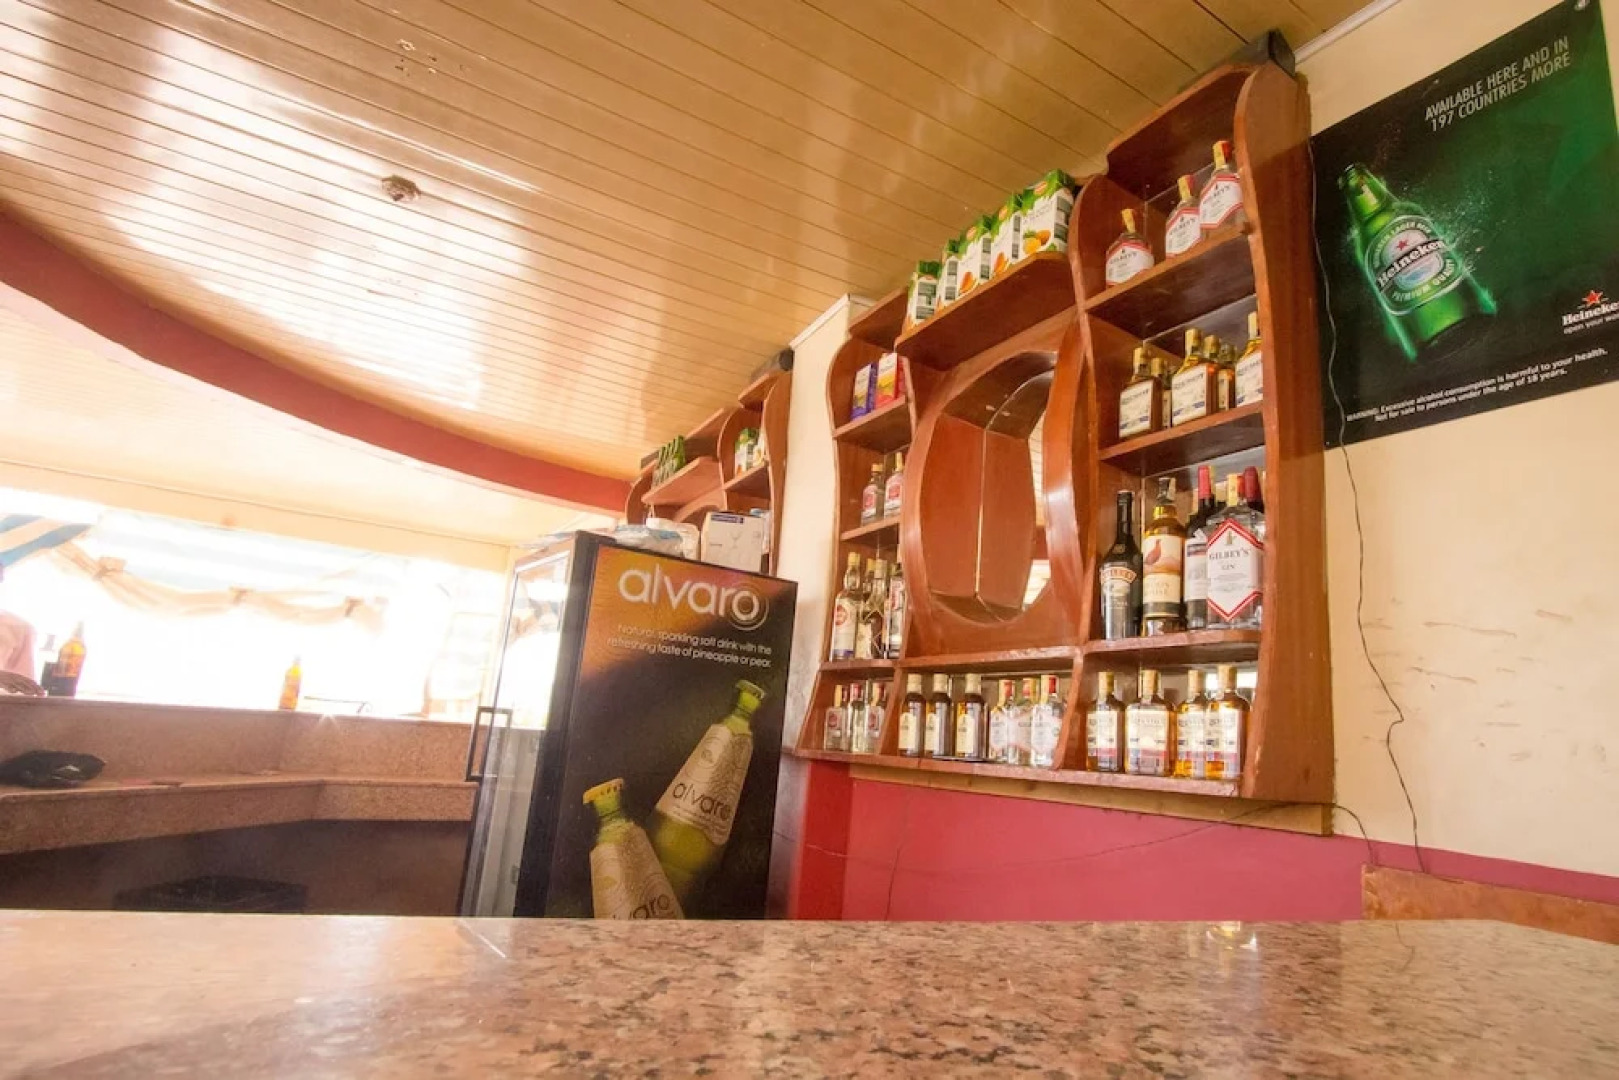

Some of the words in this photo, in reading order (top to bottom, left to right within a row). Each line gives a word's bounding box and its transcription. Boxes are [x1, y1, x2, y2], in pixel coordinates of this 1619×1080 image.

[1424, 79, 1482, 120] AVAILABLE
[1487, 62, 1518, 90] HERE
[1522, 46, 1550, 72] AND
[1554, 36, 1568, 54] IN
[1431, 111, 1453, 132] 197
[1458, 76, 1527, 119] COUNTRIES
[1532, 52, 1570, 84] MORE
[1562, 301, 1619, 326] Heineke
[1585, 318, 1604, 328] your
[1388, 410, 1400, 418] for
[1400, 406, 1416, 416] sale
[1416, 404, 1425, 412] to
[1458, 390, 1481, 402] under
[1482, 386, 1496, 394] the
[1498, 382, 1514, 391] age
[1516, 377, 1525, 386] of
[1527, 374, 1538, 384] 18
[1416, 390, 1444, 404] alcohol
[1444, 379, 1496, 397] consumption
[1506, 365, 1538, 380] harmful
[1540, 362, 1551, 371] to
[1552, 358, 1572, 370] your
[1208, 548, 1250, 560] GILBEY'S
[618, 564, 763, 622] alvaro
[607, 637, 656, 654] refreshing
[657, 644, 680, 656] taste
[682, 646, 692, 656] of
[693, 648, 738, 664] pineapple
[740, 656, 748, 664] or
[700, 636, 716, 646] soft
[717, 638, 738, 650] drink
[740, 642, 756, 652] with
[758, 644, 772, 654] the
[673, 782, 731, 820] alvaro
